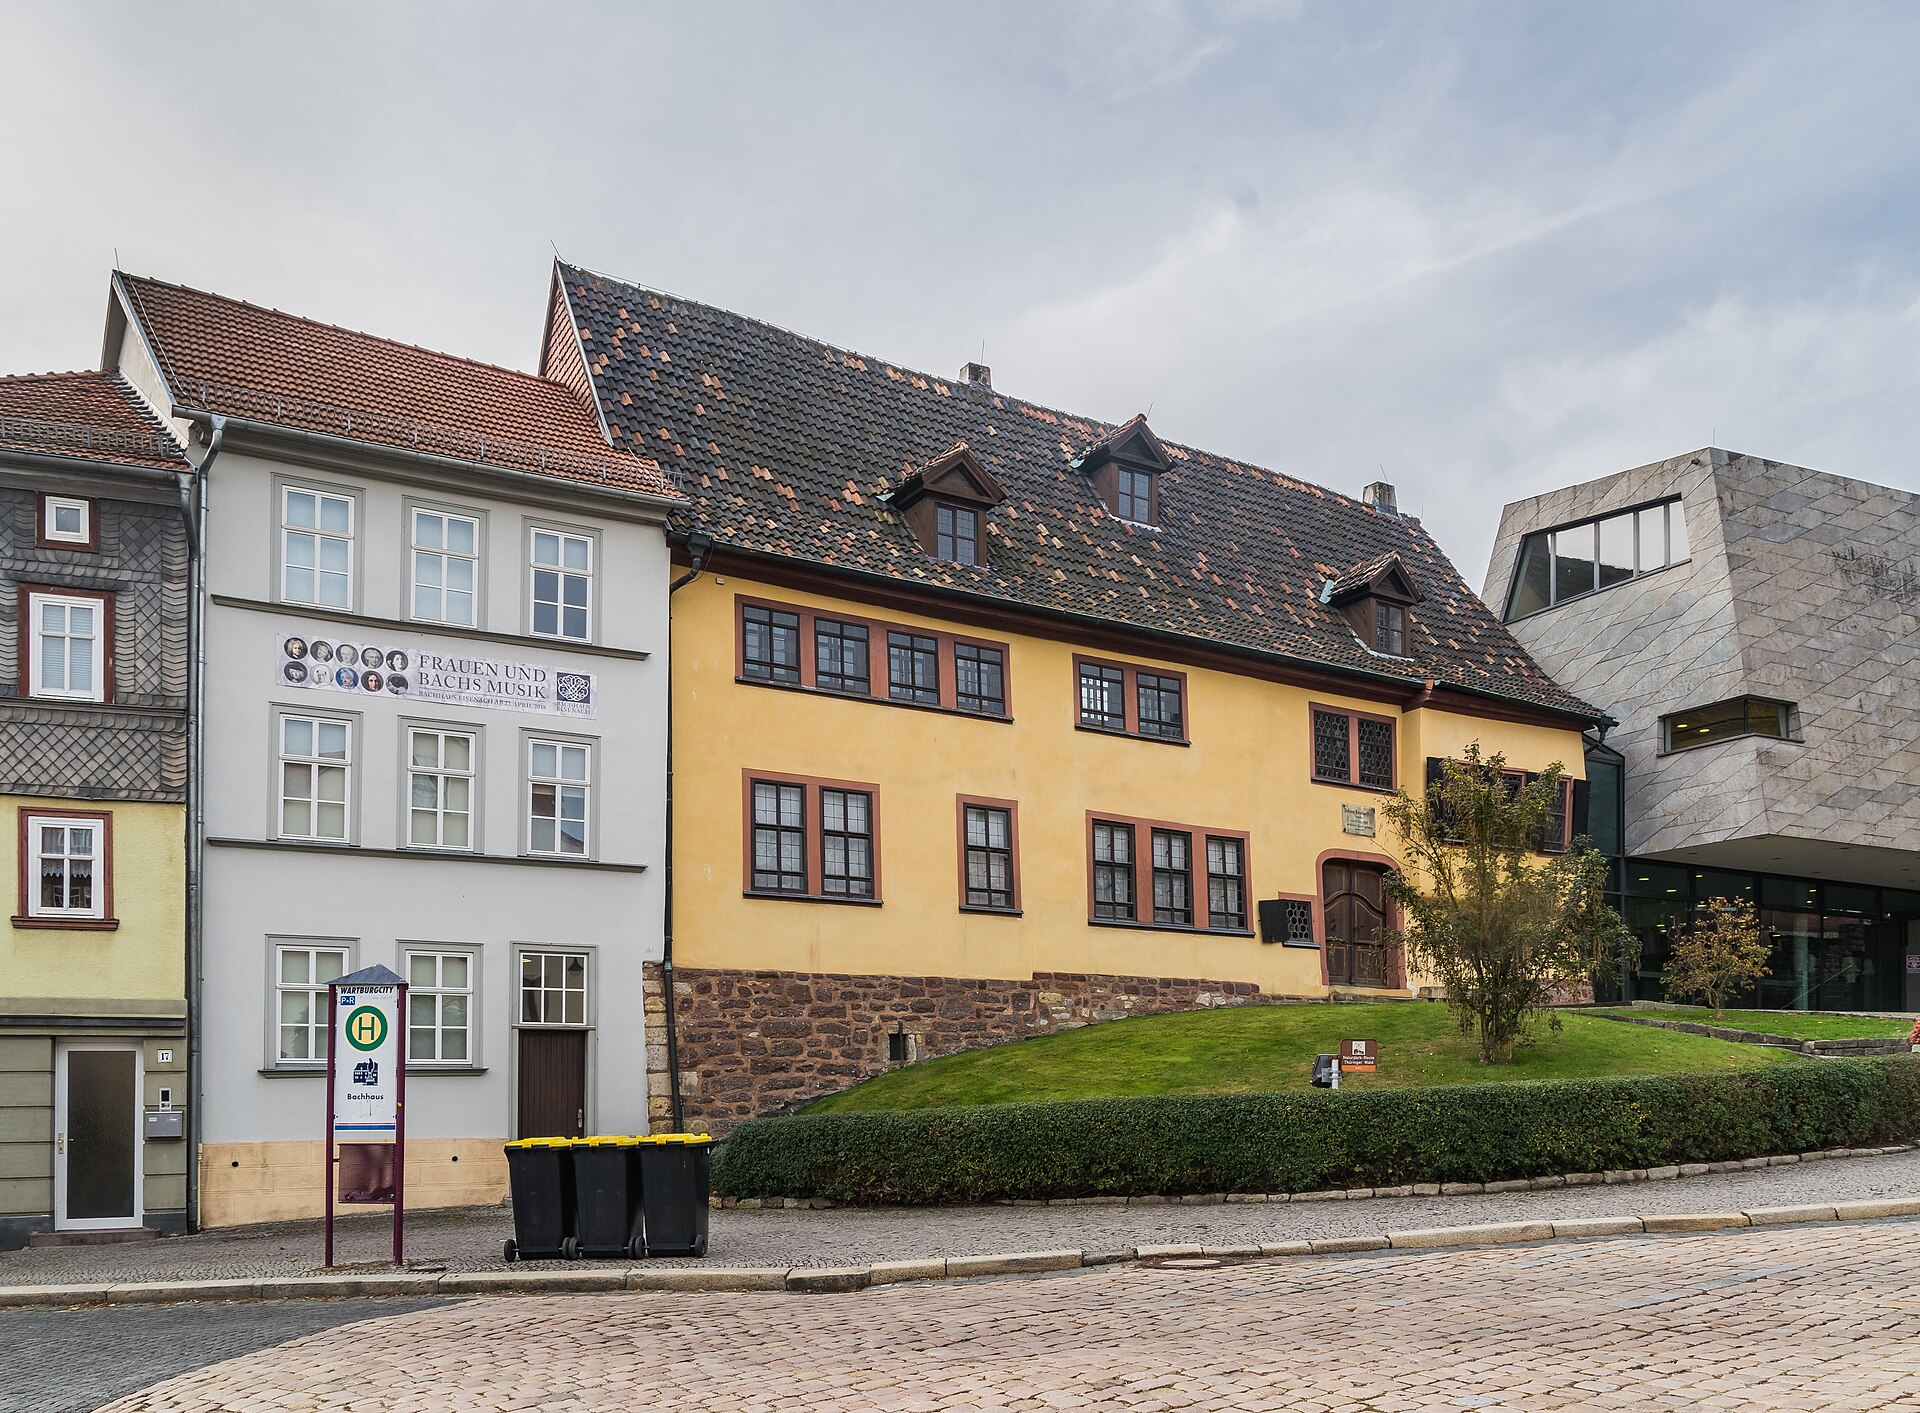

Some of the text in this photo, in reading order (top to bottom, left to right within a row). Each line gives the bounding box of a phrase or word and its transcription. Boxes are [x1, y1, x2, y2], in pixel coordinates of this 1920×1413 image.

[419, 654, 546, 683] FRAUEN UND
[419, 672, 546, 699] BACHS MUSIK
[512, 701, 534, 709] APRIL
[340, 986, 394, 995] WARTBURGCITY
[358, 1016, 374, 1040] H
[347, 1092, 384, 1100] Bachhaus
